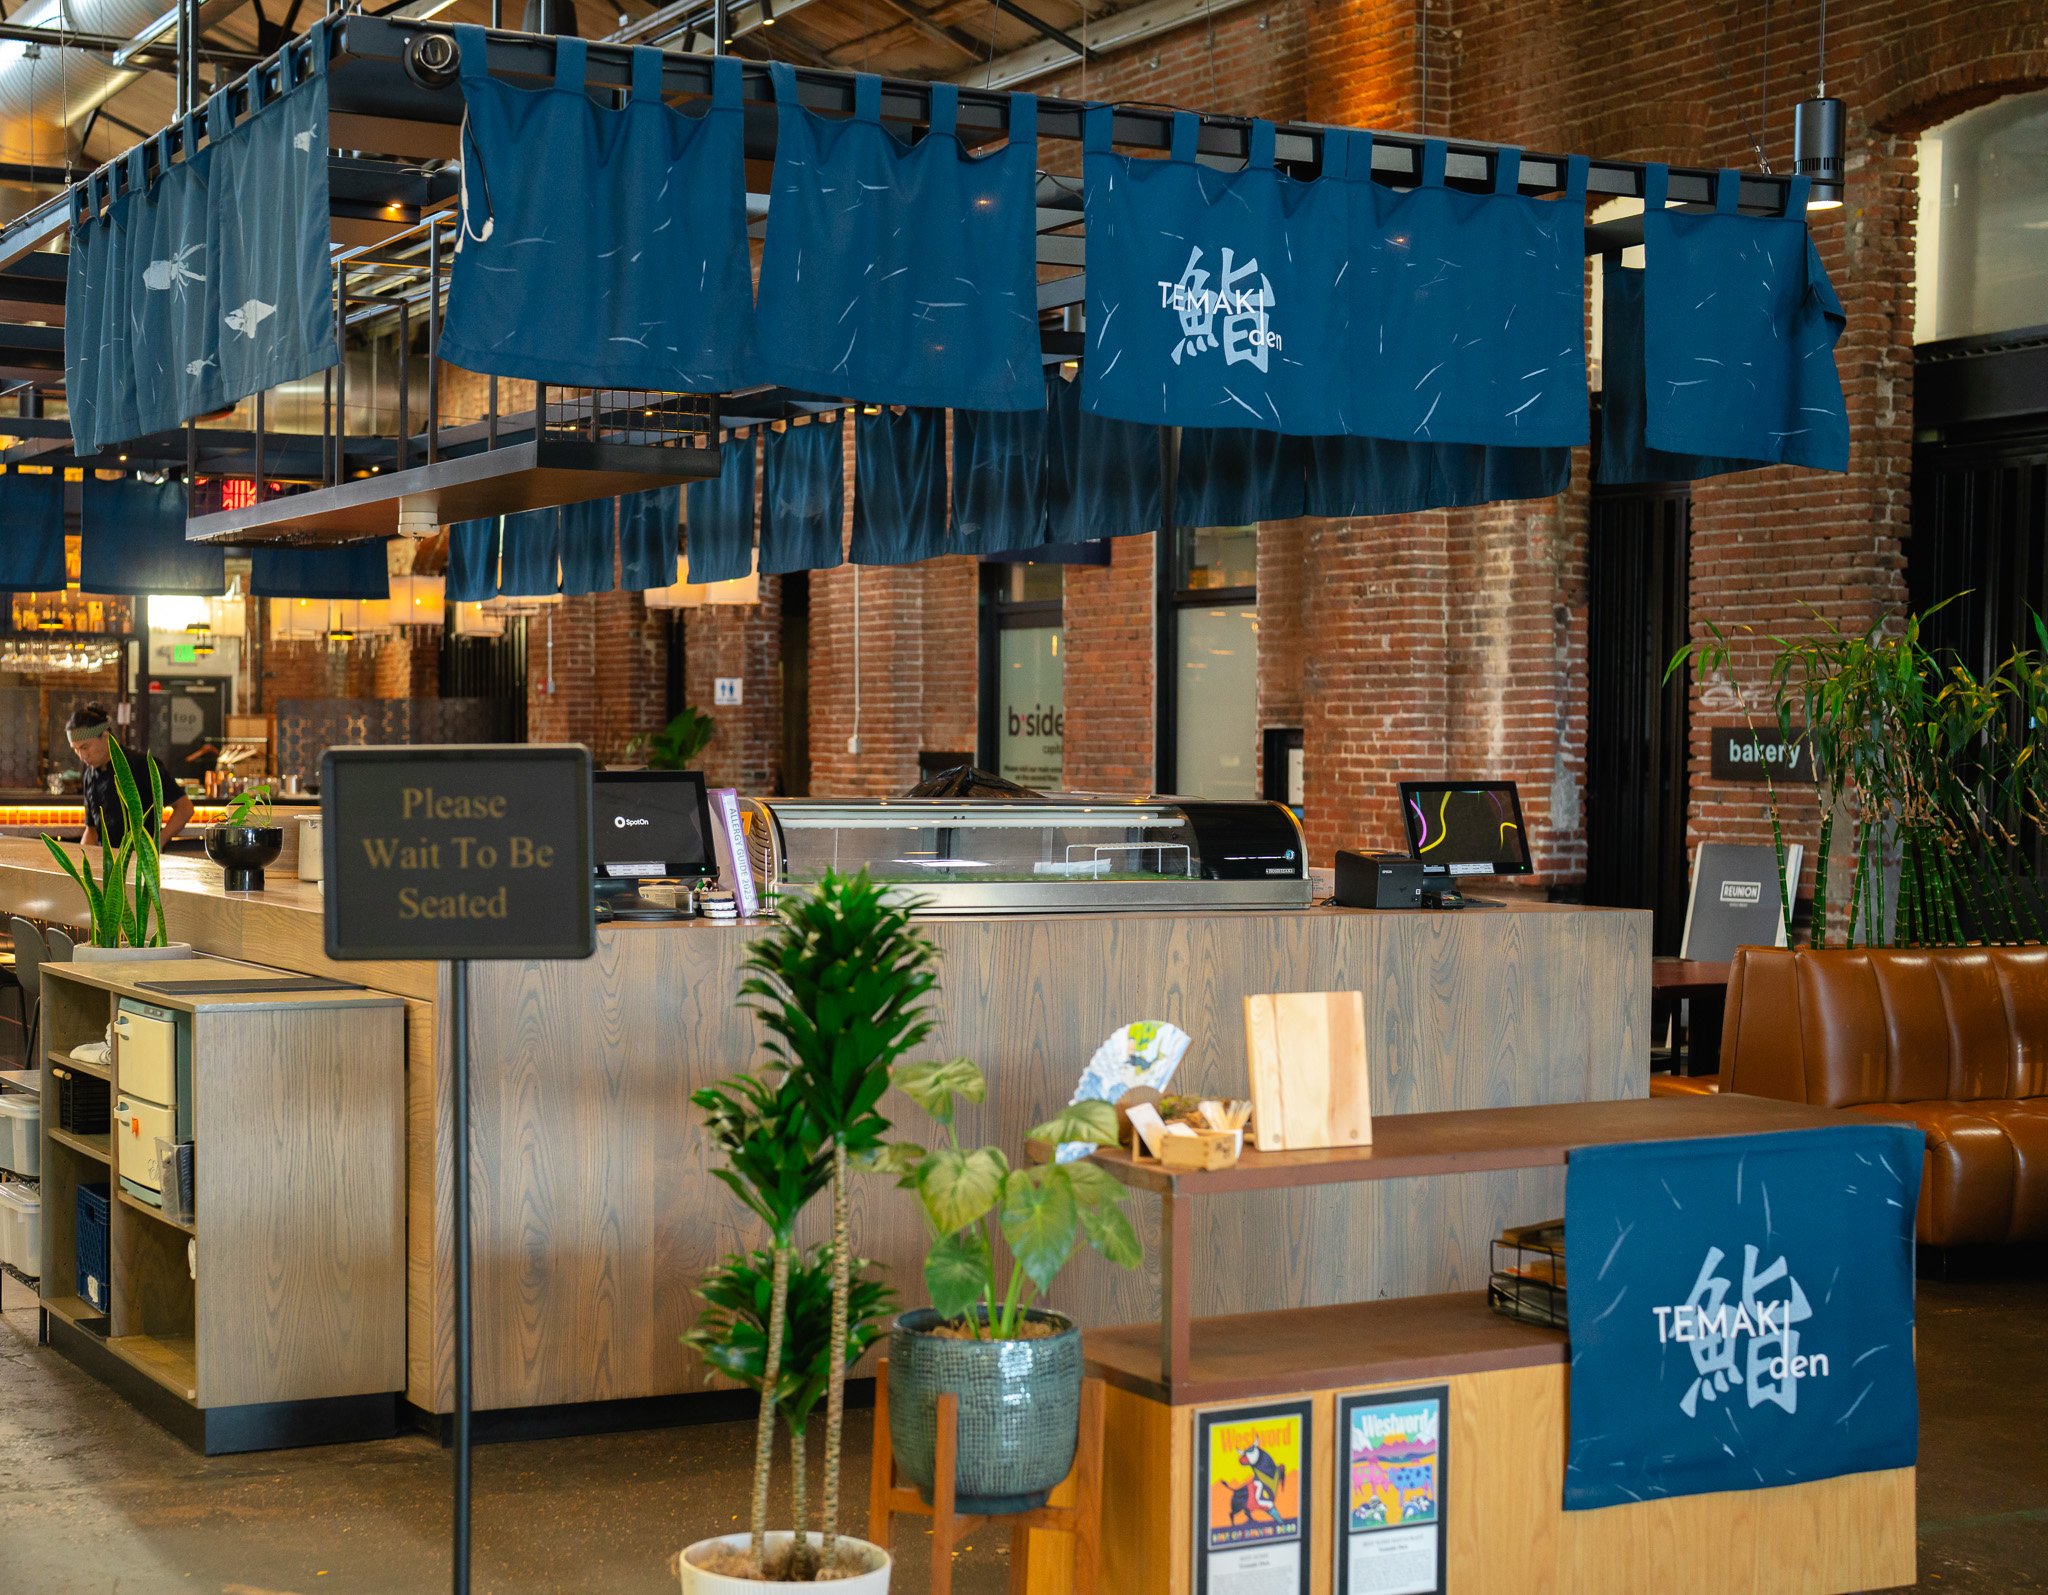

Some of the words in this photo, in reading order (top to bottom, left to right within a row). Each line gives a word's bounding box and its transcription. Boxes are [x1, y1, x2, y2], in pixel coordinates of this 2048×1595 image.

[1158, 281, 1264, 317] TEMAKI
[1248, 319, 1282, 351] den
[1729, 738, 1801, 769] bakery
[402, 787, 508, 820] Please
[625, 818, 650, 827] SpotOn
[362, 836, 440, 869] Wait
[451, 836, 498, 869] To
[510, 836, 554, 869] Be
[729, 807, 743, 847] ALLERGY
[736, 847, 748, 877] GUIDE
[399, 885, 509, 919] Seated
[1723, 885, 1758, 898] REUNION
[1652, 1299, 1790, 1344] TEMAKI
[1768, 1339, 1829, 1380] den
[1361, 1408, 1429, 1438] Westword
